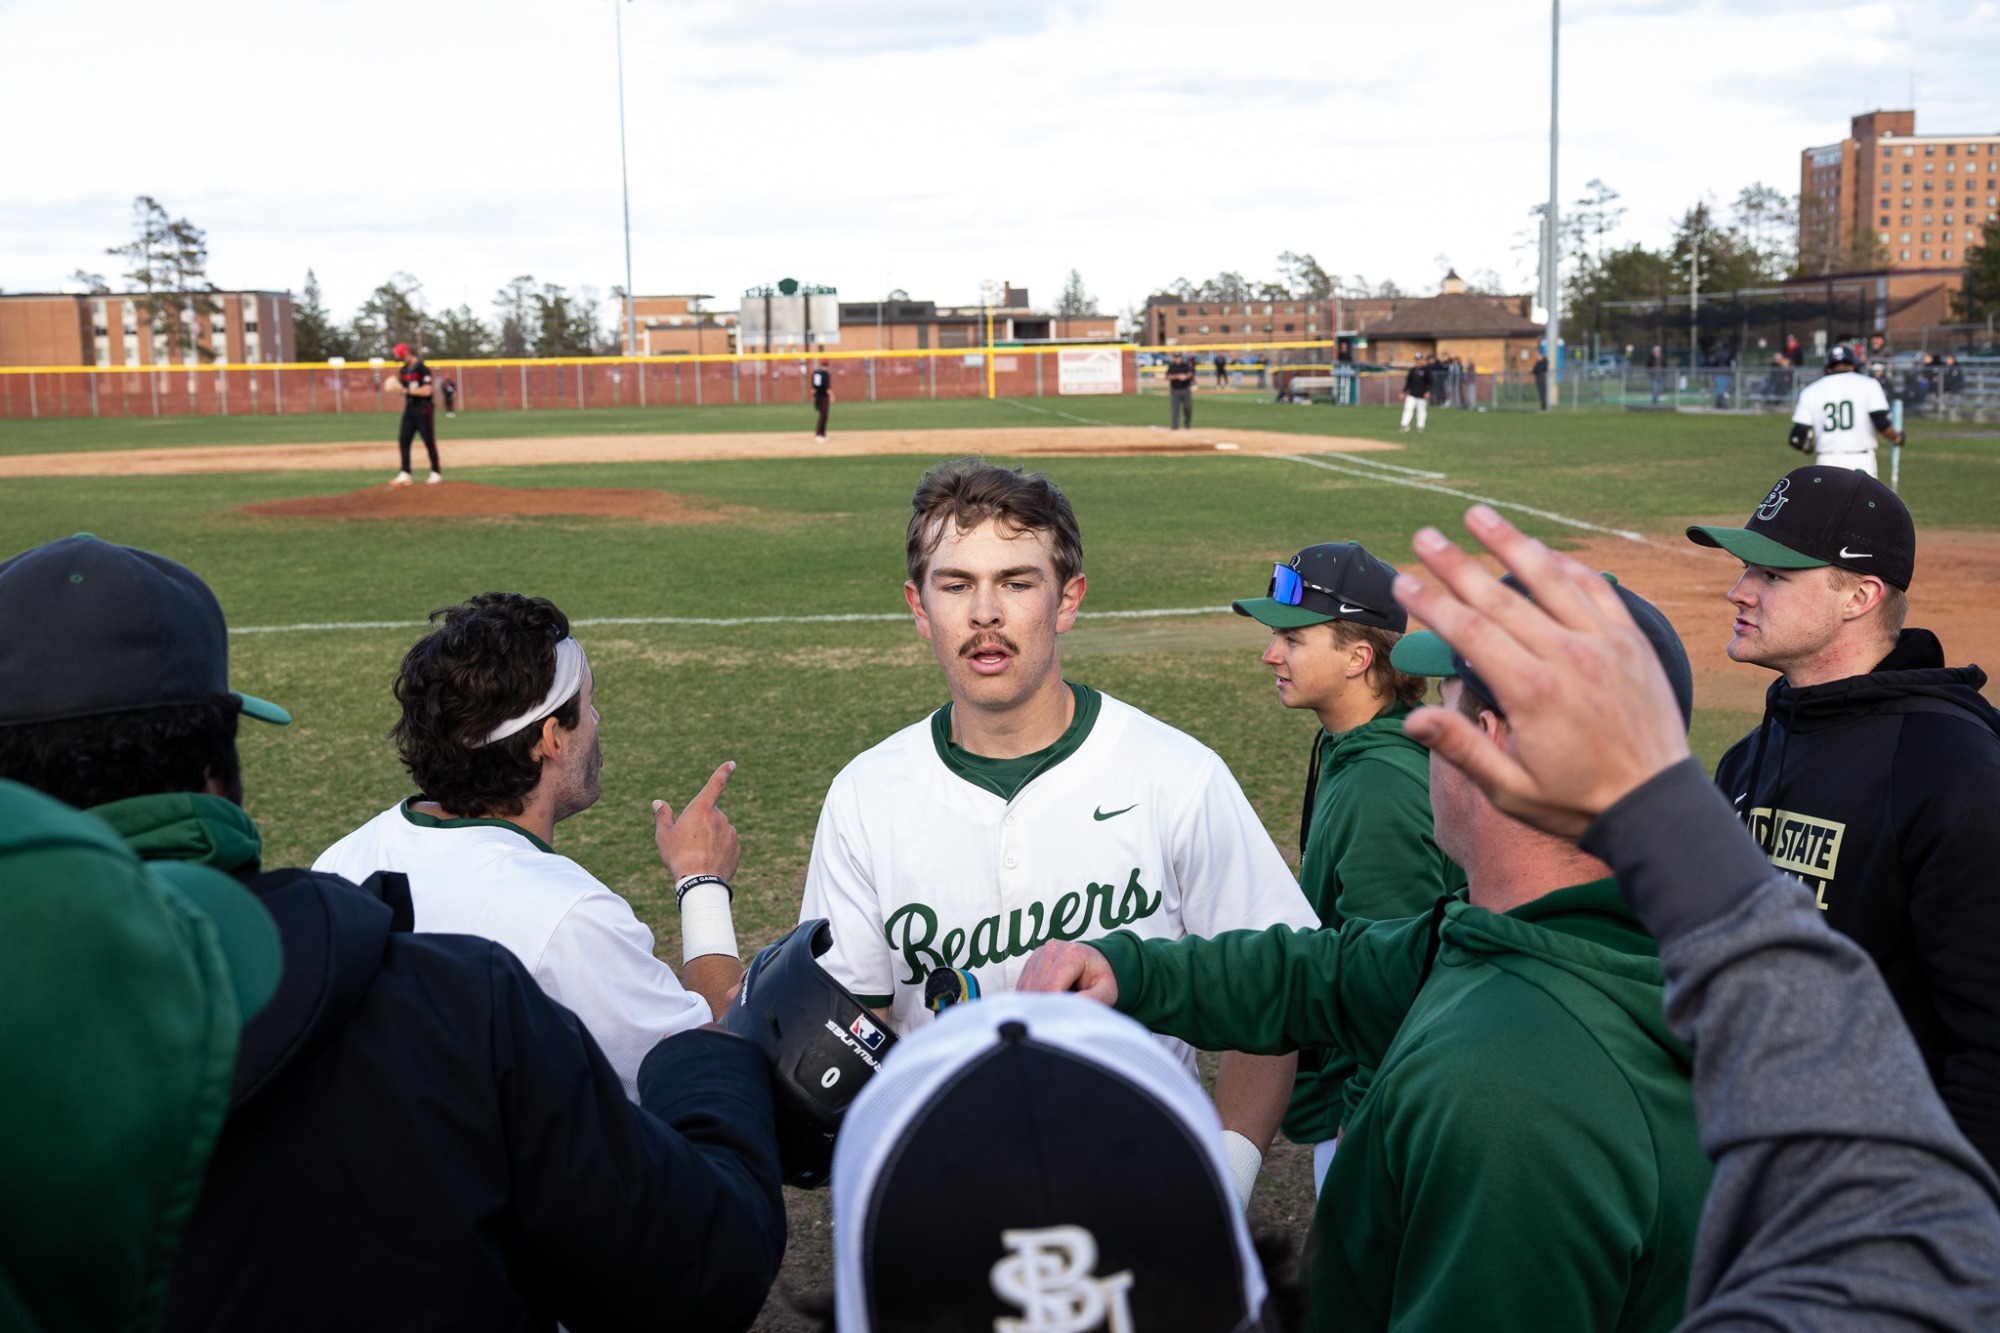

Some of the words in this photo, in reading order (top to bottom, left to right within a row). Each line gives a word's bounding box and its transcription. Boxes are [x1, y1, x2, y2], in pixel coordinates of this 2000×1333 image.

[1823, 401, 1853, 432] 30
[1776, 819, 1838, 870] STATE
[684, 879, 698, 889] THE
[884, 867, 1162, 985] Beavers
